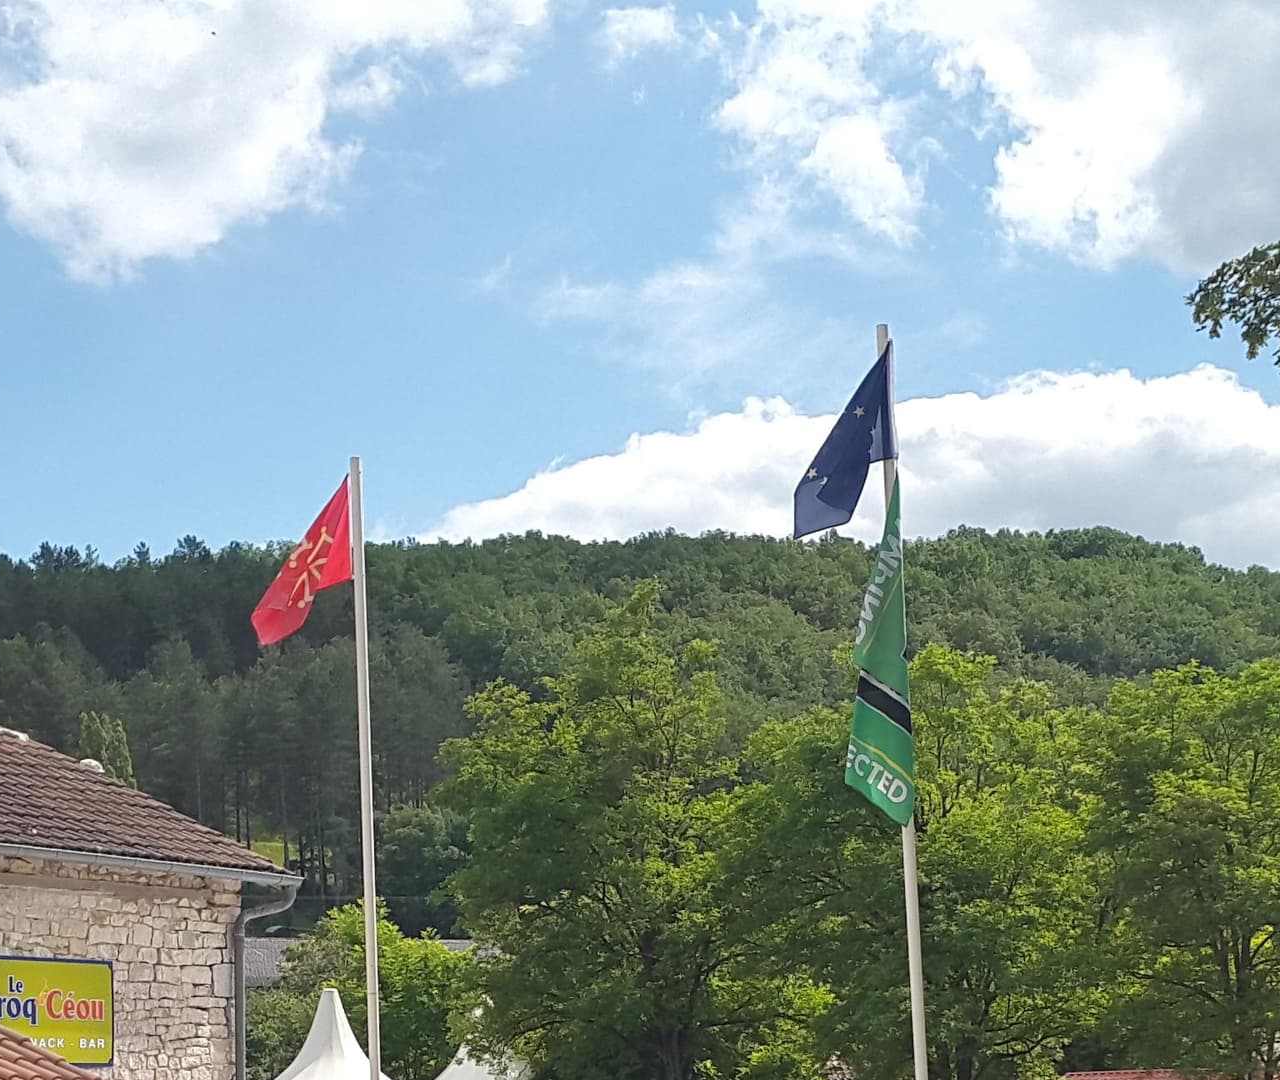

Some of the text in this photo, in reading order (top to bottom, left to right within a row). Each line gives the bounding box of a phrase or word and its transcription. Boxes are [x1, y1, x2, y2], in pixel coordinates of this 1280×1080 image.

[8, 975, 24, 993] Le
[29, 1037, 65, 1049] NACK
[79, 1038, 106, 1049] BAR
